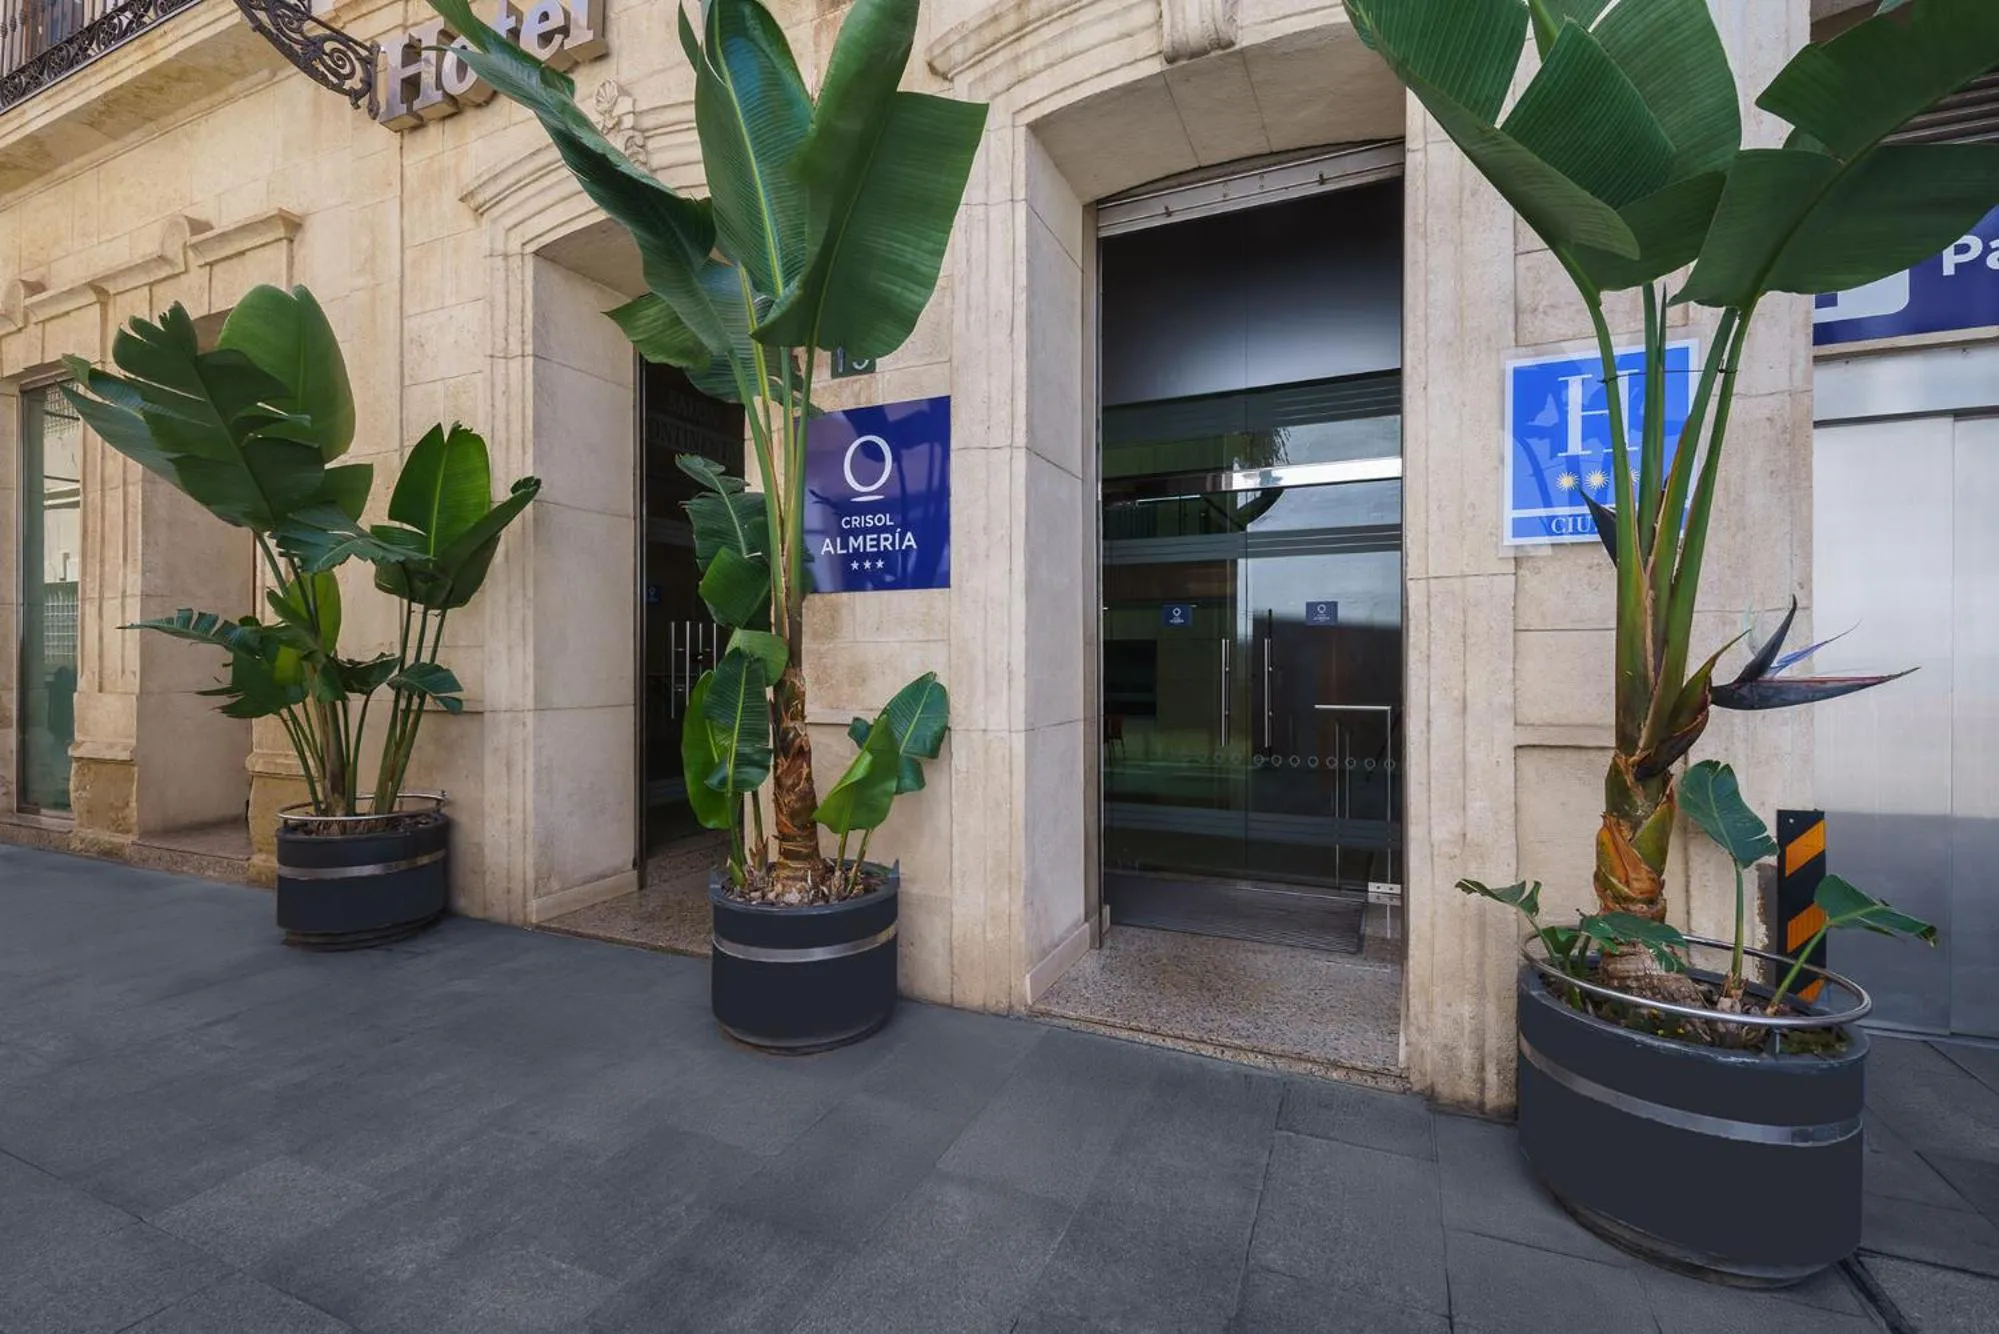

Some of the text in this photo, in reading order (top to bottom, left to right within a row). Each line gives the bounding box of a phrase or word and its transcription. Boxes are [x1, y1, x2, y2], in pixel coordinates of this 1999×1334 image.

[1557, 369, 1640, 457] H
[841, 513, 895, 529] CRISOL
[1551, 516, 1599, 534] CIU
[820, 528, 918, 555] ALMERÍA
